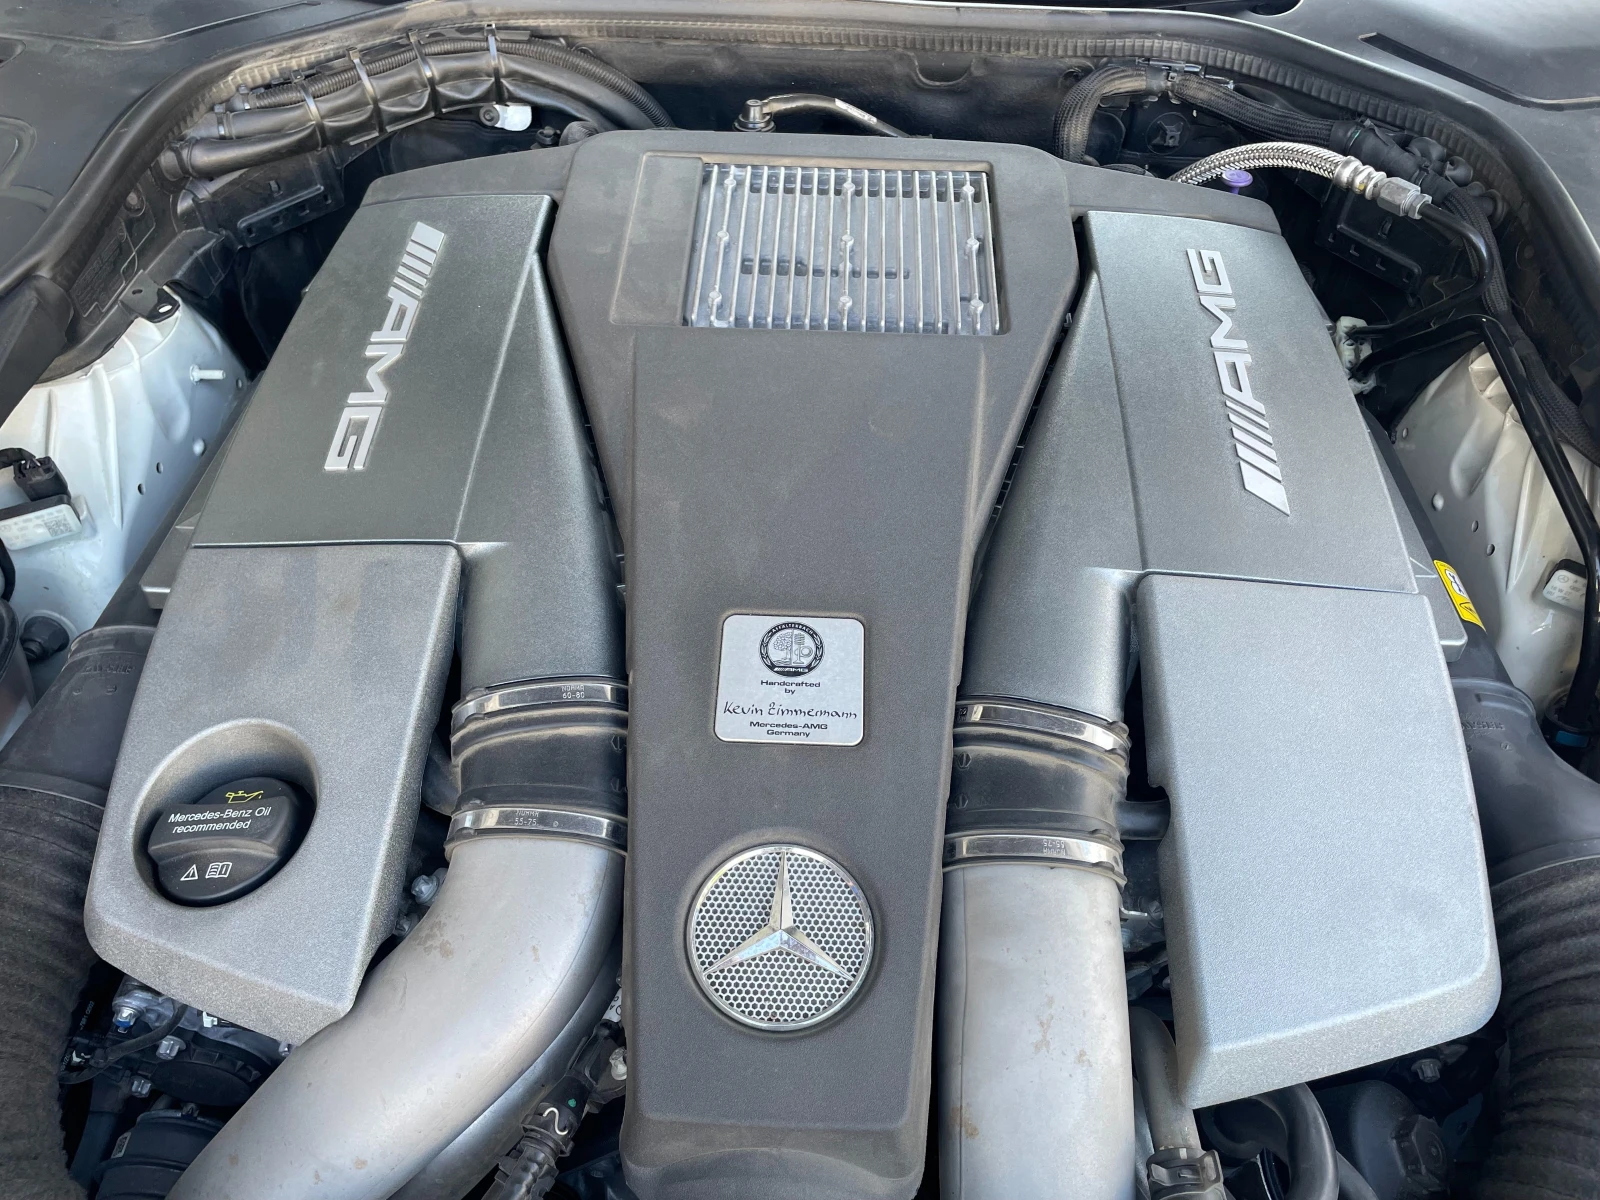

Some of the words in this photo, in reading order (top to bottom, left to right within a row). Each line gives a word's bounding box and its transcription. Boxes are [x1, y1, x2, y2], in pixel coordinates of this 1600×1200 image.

[760, 680, 821, 688] Handcrafted
[562, 691, 585, 699] 60-80
[723, 700, 763, 716] Kevin
[767, 701, 858, 720] Zimmermann
[749, 721, 828, 730] Mercedes-AMG
[766, 729, 811, 738] Germany
[168, 809, 253, 823] Mercedes-Benz
[254, 806, 272, 817] Oil
[172, 819, 251, 834] recommended
